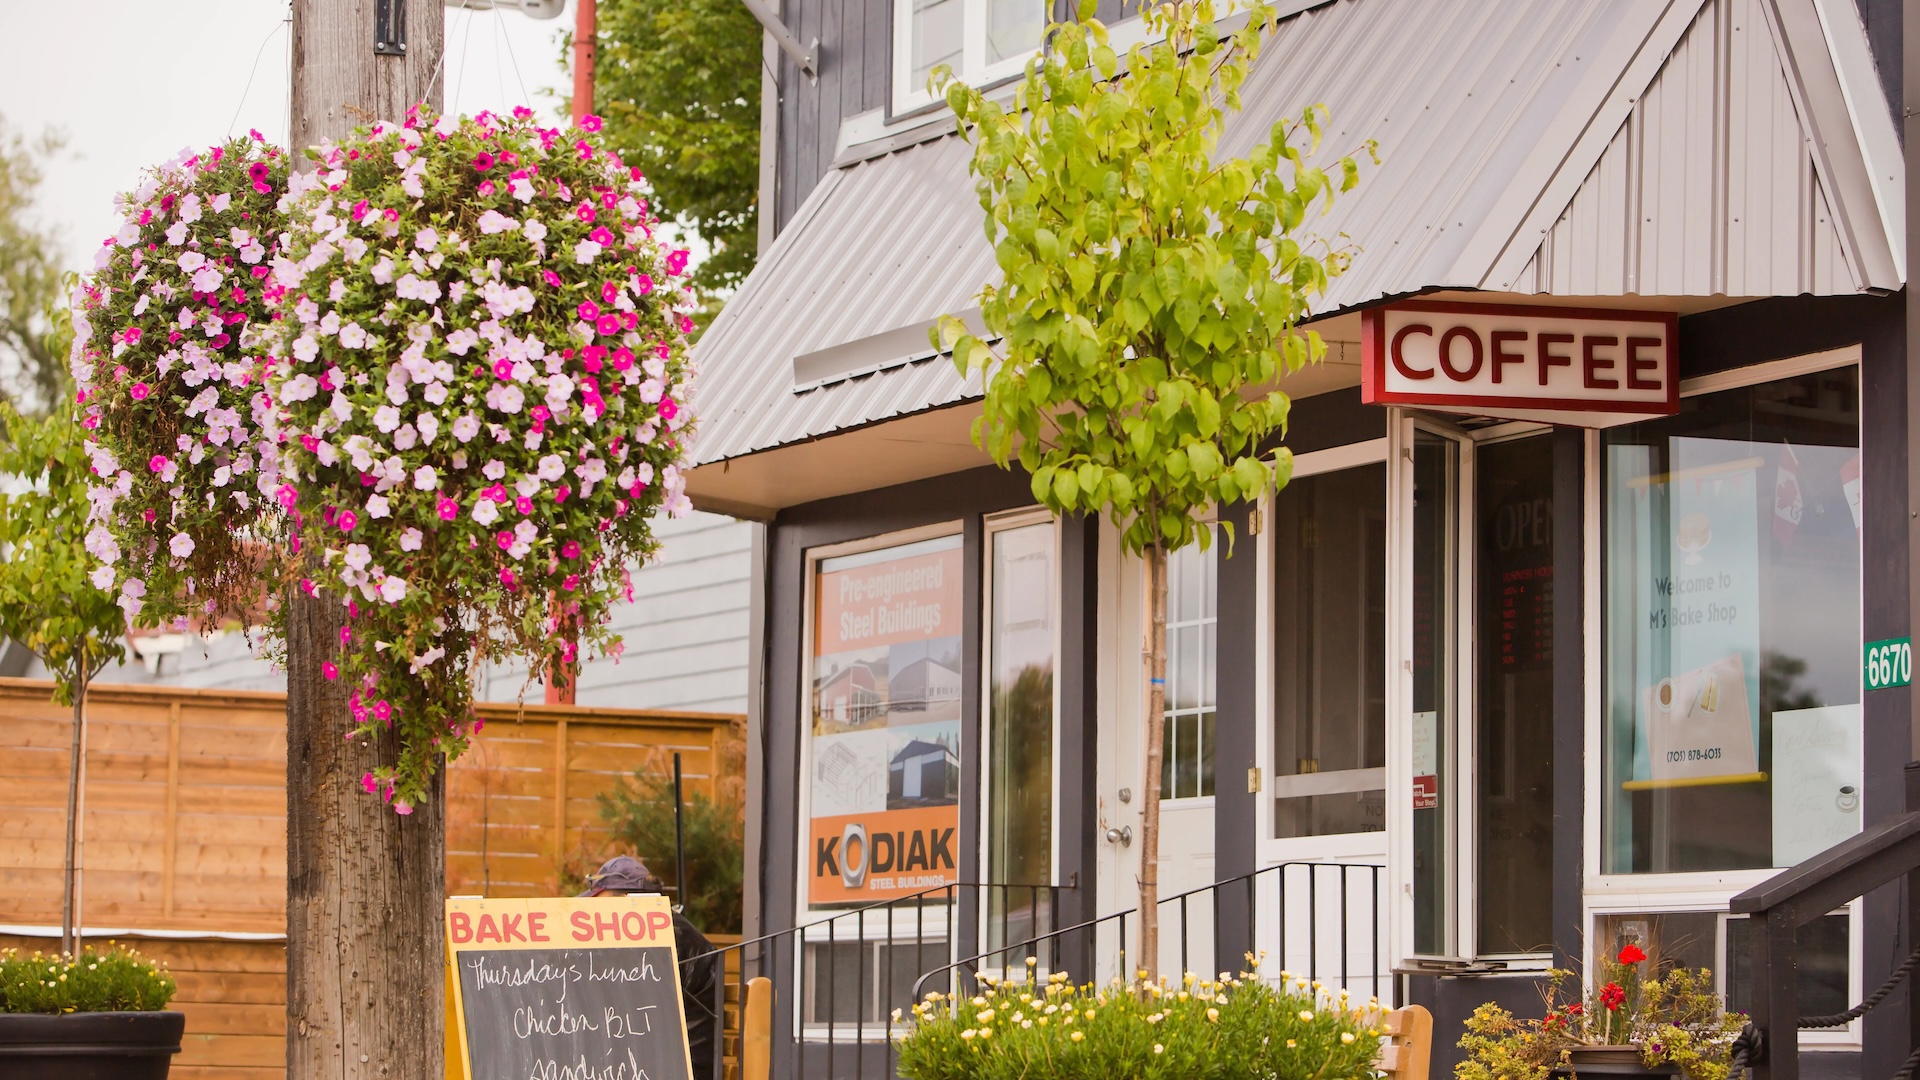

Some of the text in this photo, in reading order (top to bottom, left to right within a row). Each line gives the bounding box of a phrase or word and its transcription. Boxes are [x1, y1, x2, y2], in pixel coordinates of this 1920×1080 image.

[1390, 323, 1663, 390] COFFEE
[840, 557, 943, 605] Pre-engineered
[1655, 571, 1732, 597] Welcome to
[840, 600, 942, 641] Steel Buildings
[1650, 602, 1737, 630] M's Bake Shop
[1868, 641, 1912, 687] 6670
[1666, 748, 1722, 763] (705) 878-6035
[816, 823, 956, 887] KODIAK
[870, 877, 896, 891] STEEL
[897, 874, 945, 889] BUILDINGS
[449, 910, 671, 944] BAKE SHOP
[467, 951, 662, 1004] Thursday's Lunch
[513, 998, 657, 1039] Chicken BLT
